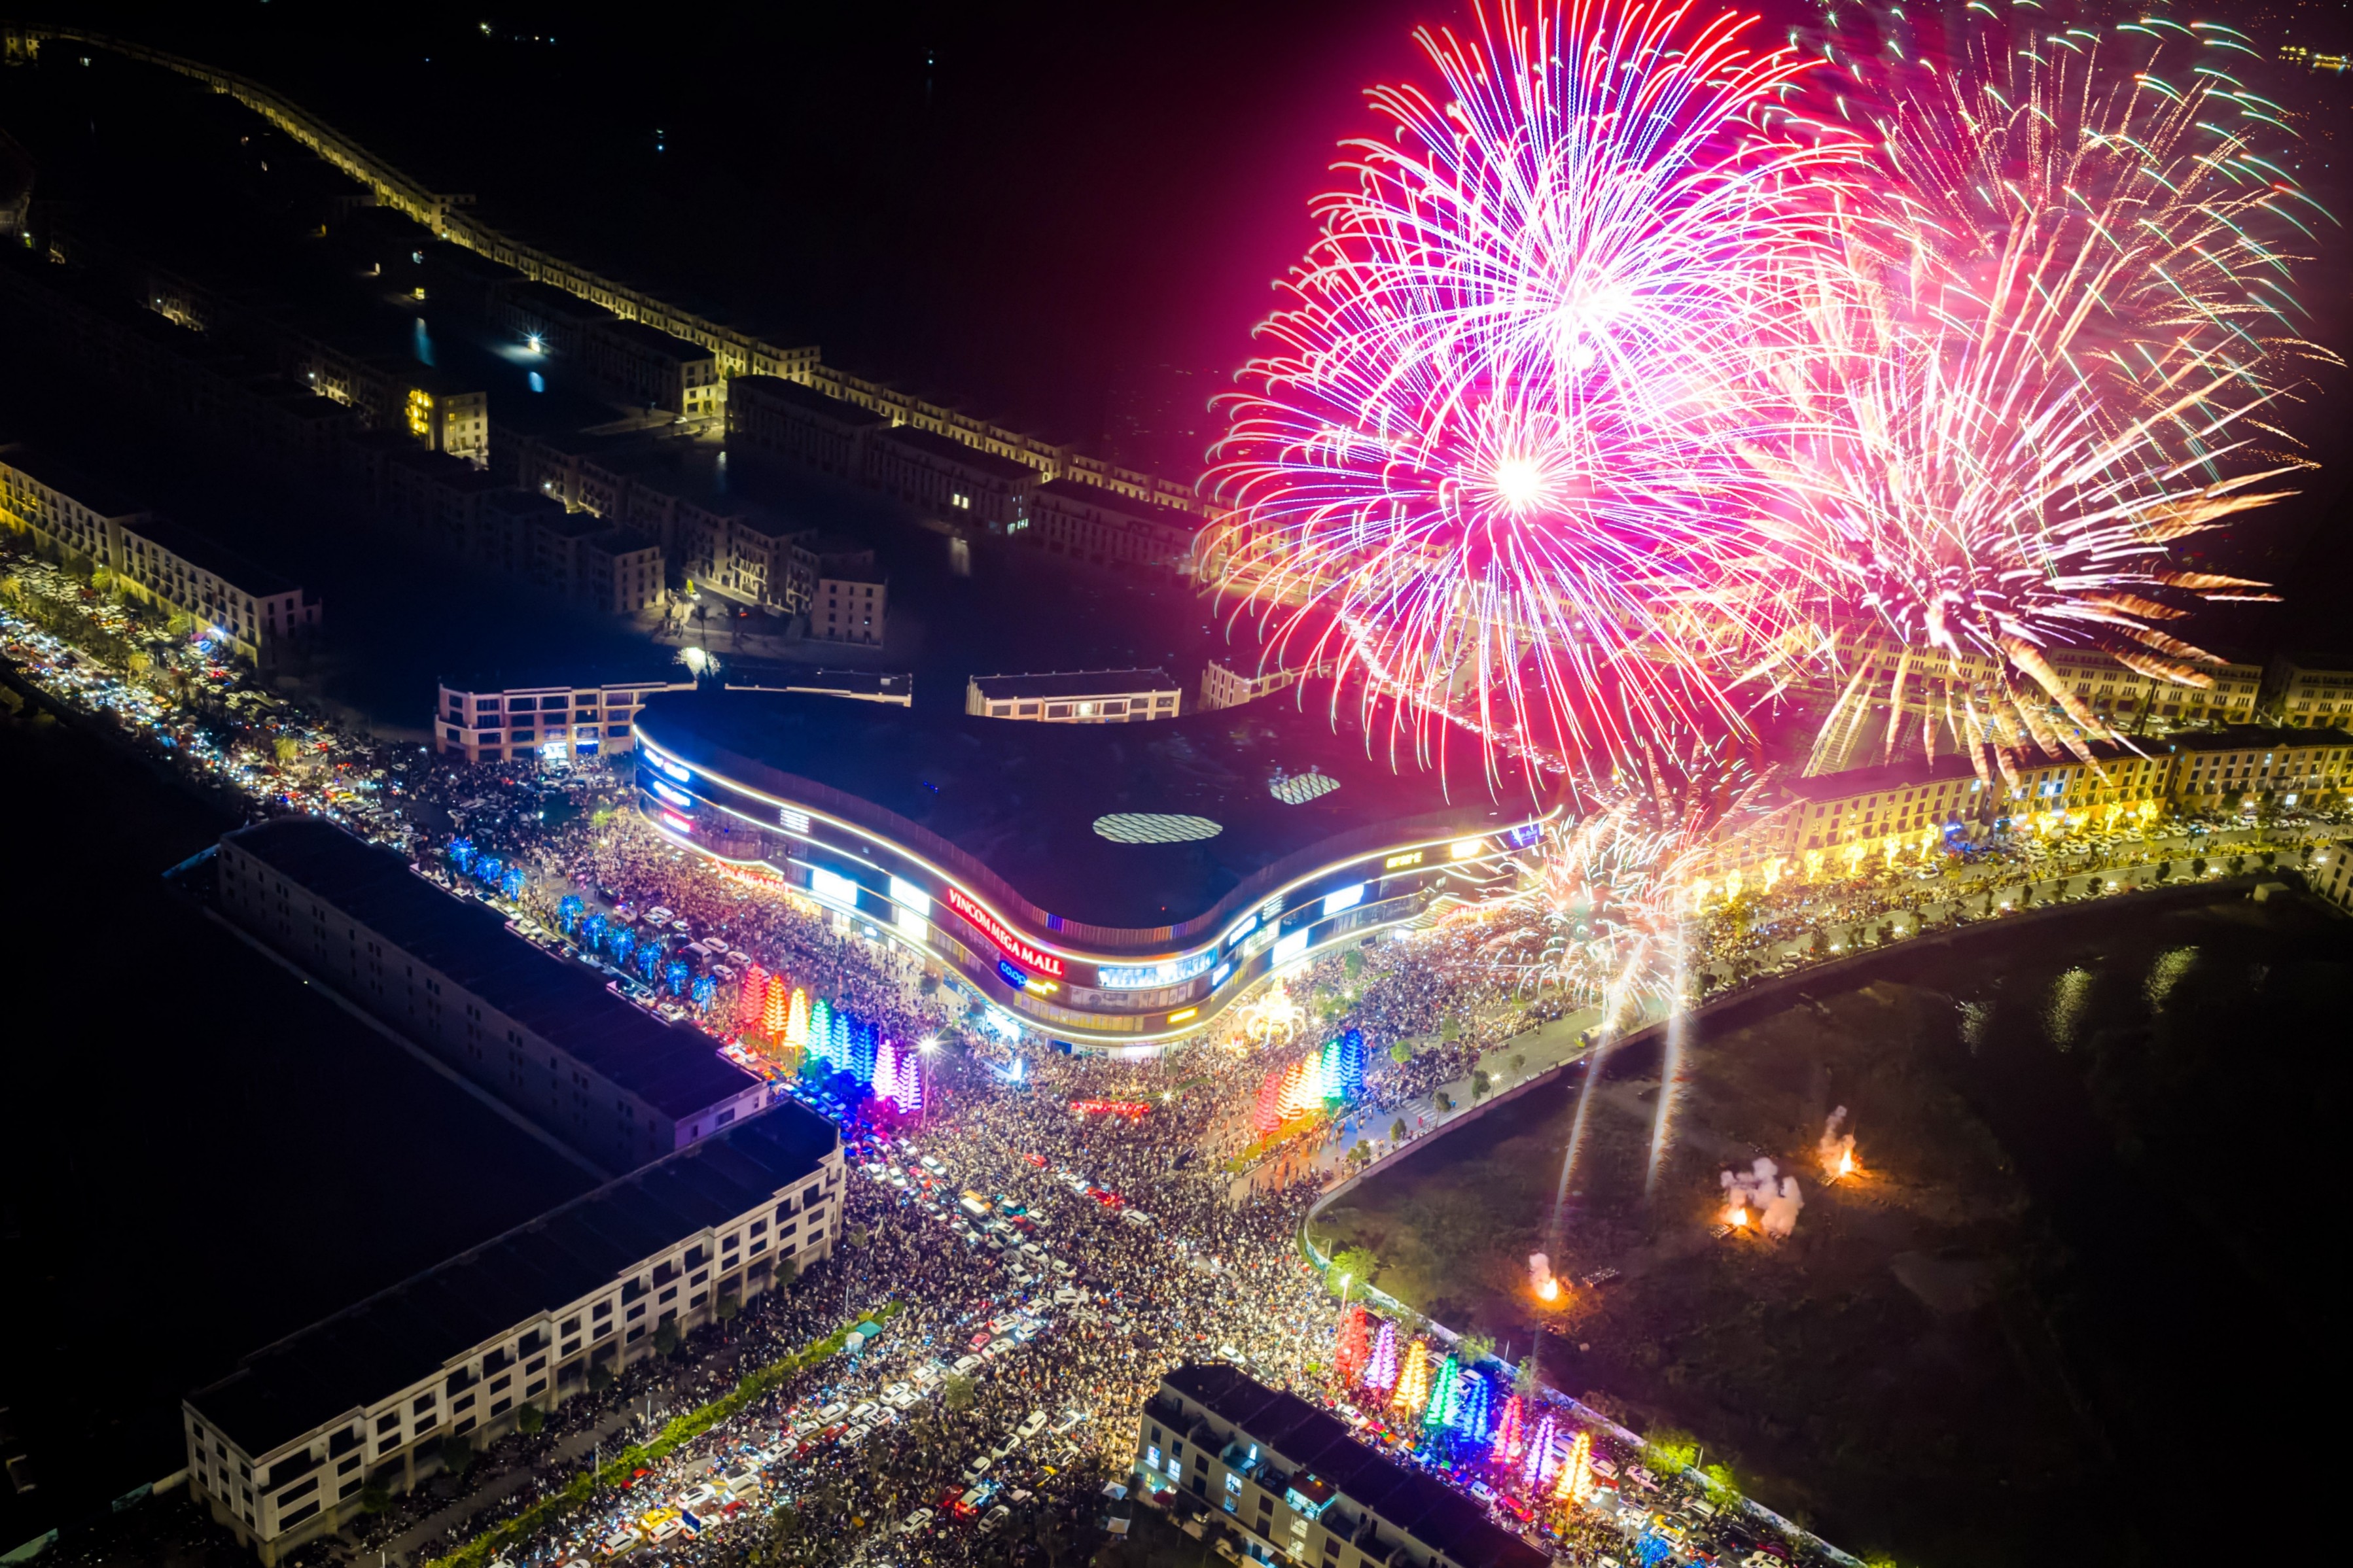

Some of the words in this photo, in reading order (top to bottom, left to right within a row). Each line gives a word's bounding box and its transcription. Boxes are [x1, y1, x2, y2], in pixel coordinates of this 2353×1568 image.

[949, 888, 991, 932] VINCOM
[991, 922, 1020, 957] MEGA
[1021, 947, 1062, 975] MALL
